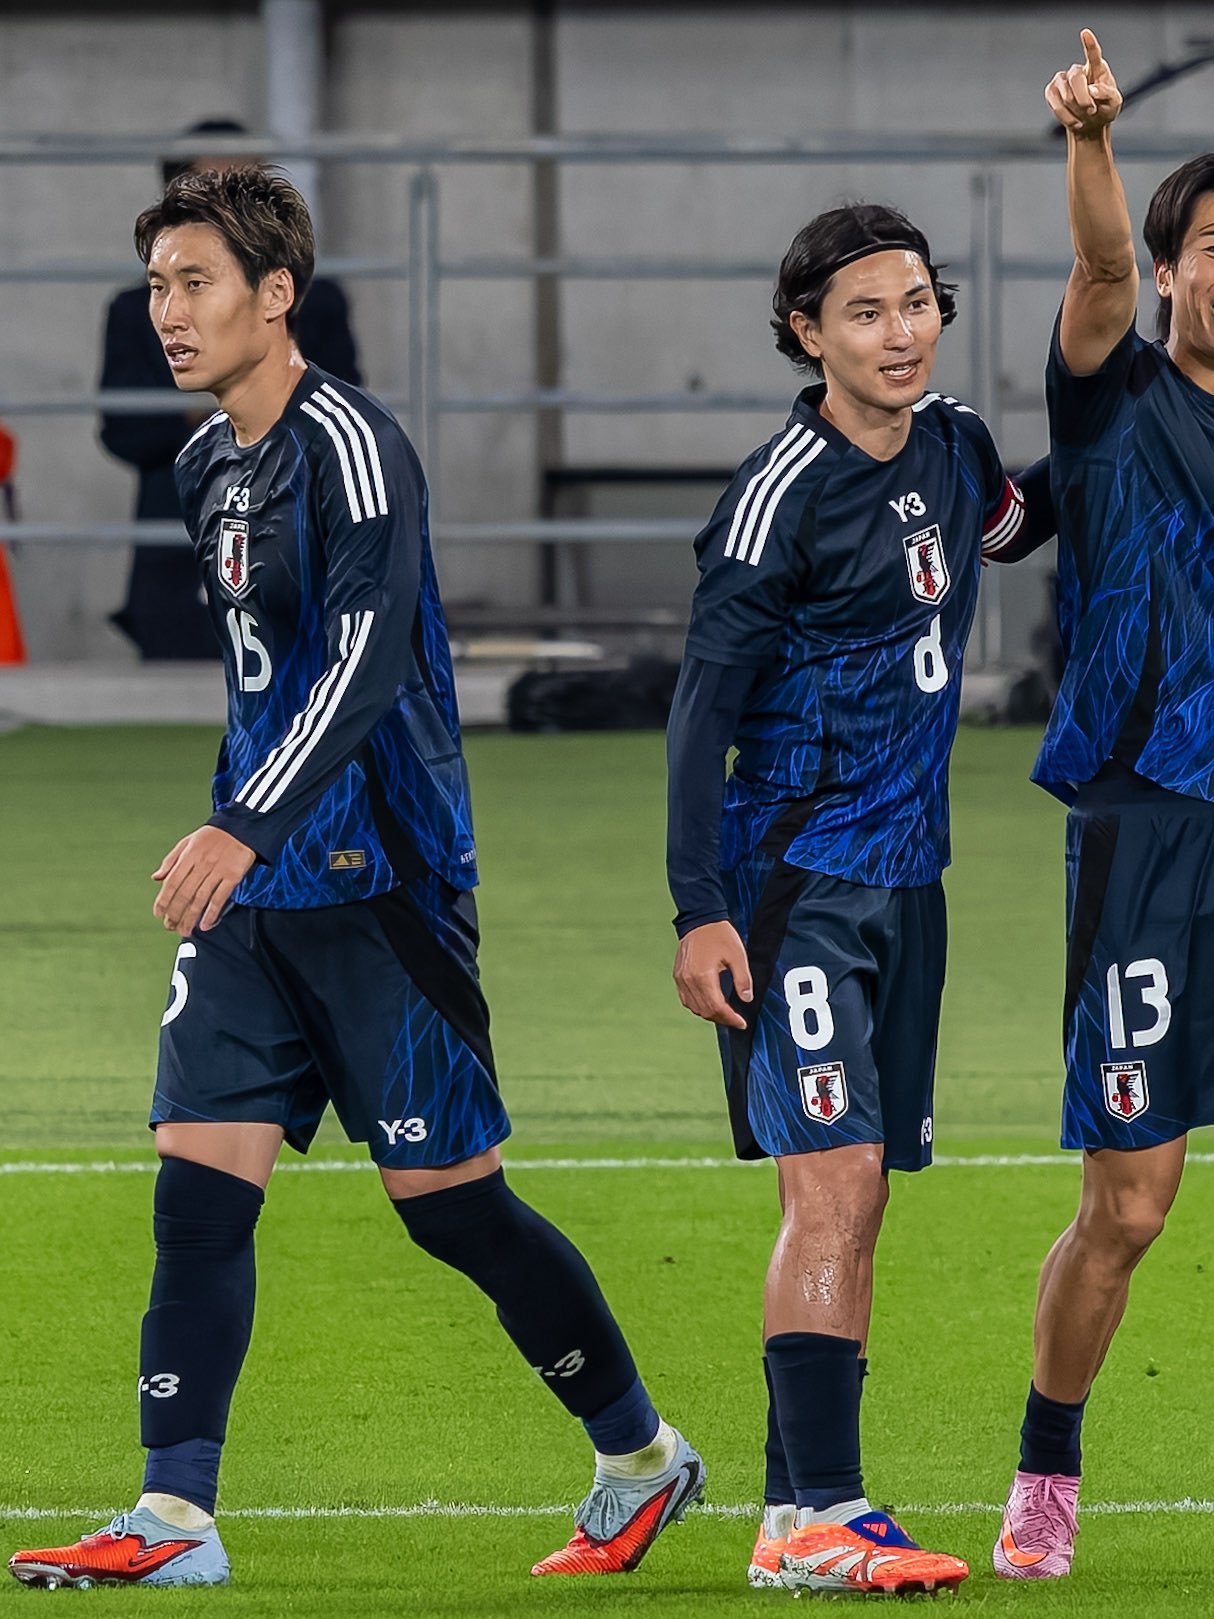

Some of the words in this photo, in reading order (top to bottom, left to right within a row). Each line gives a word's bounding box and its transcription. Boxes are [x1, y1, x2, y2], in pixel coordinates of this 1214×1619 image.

[223, 487, 250, 511] Y-3
[889, 491, 927, 522] Y-3
[226, 607, 273, 692] 15
[784, 965, 835, 1051] 8
[1107, 958, 1172, 1049] 13
[378, 1117, 427, 1145] Y-3
[532, 1349, 585, 1377] -3
